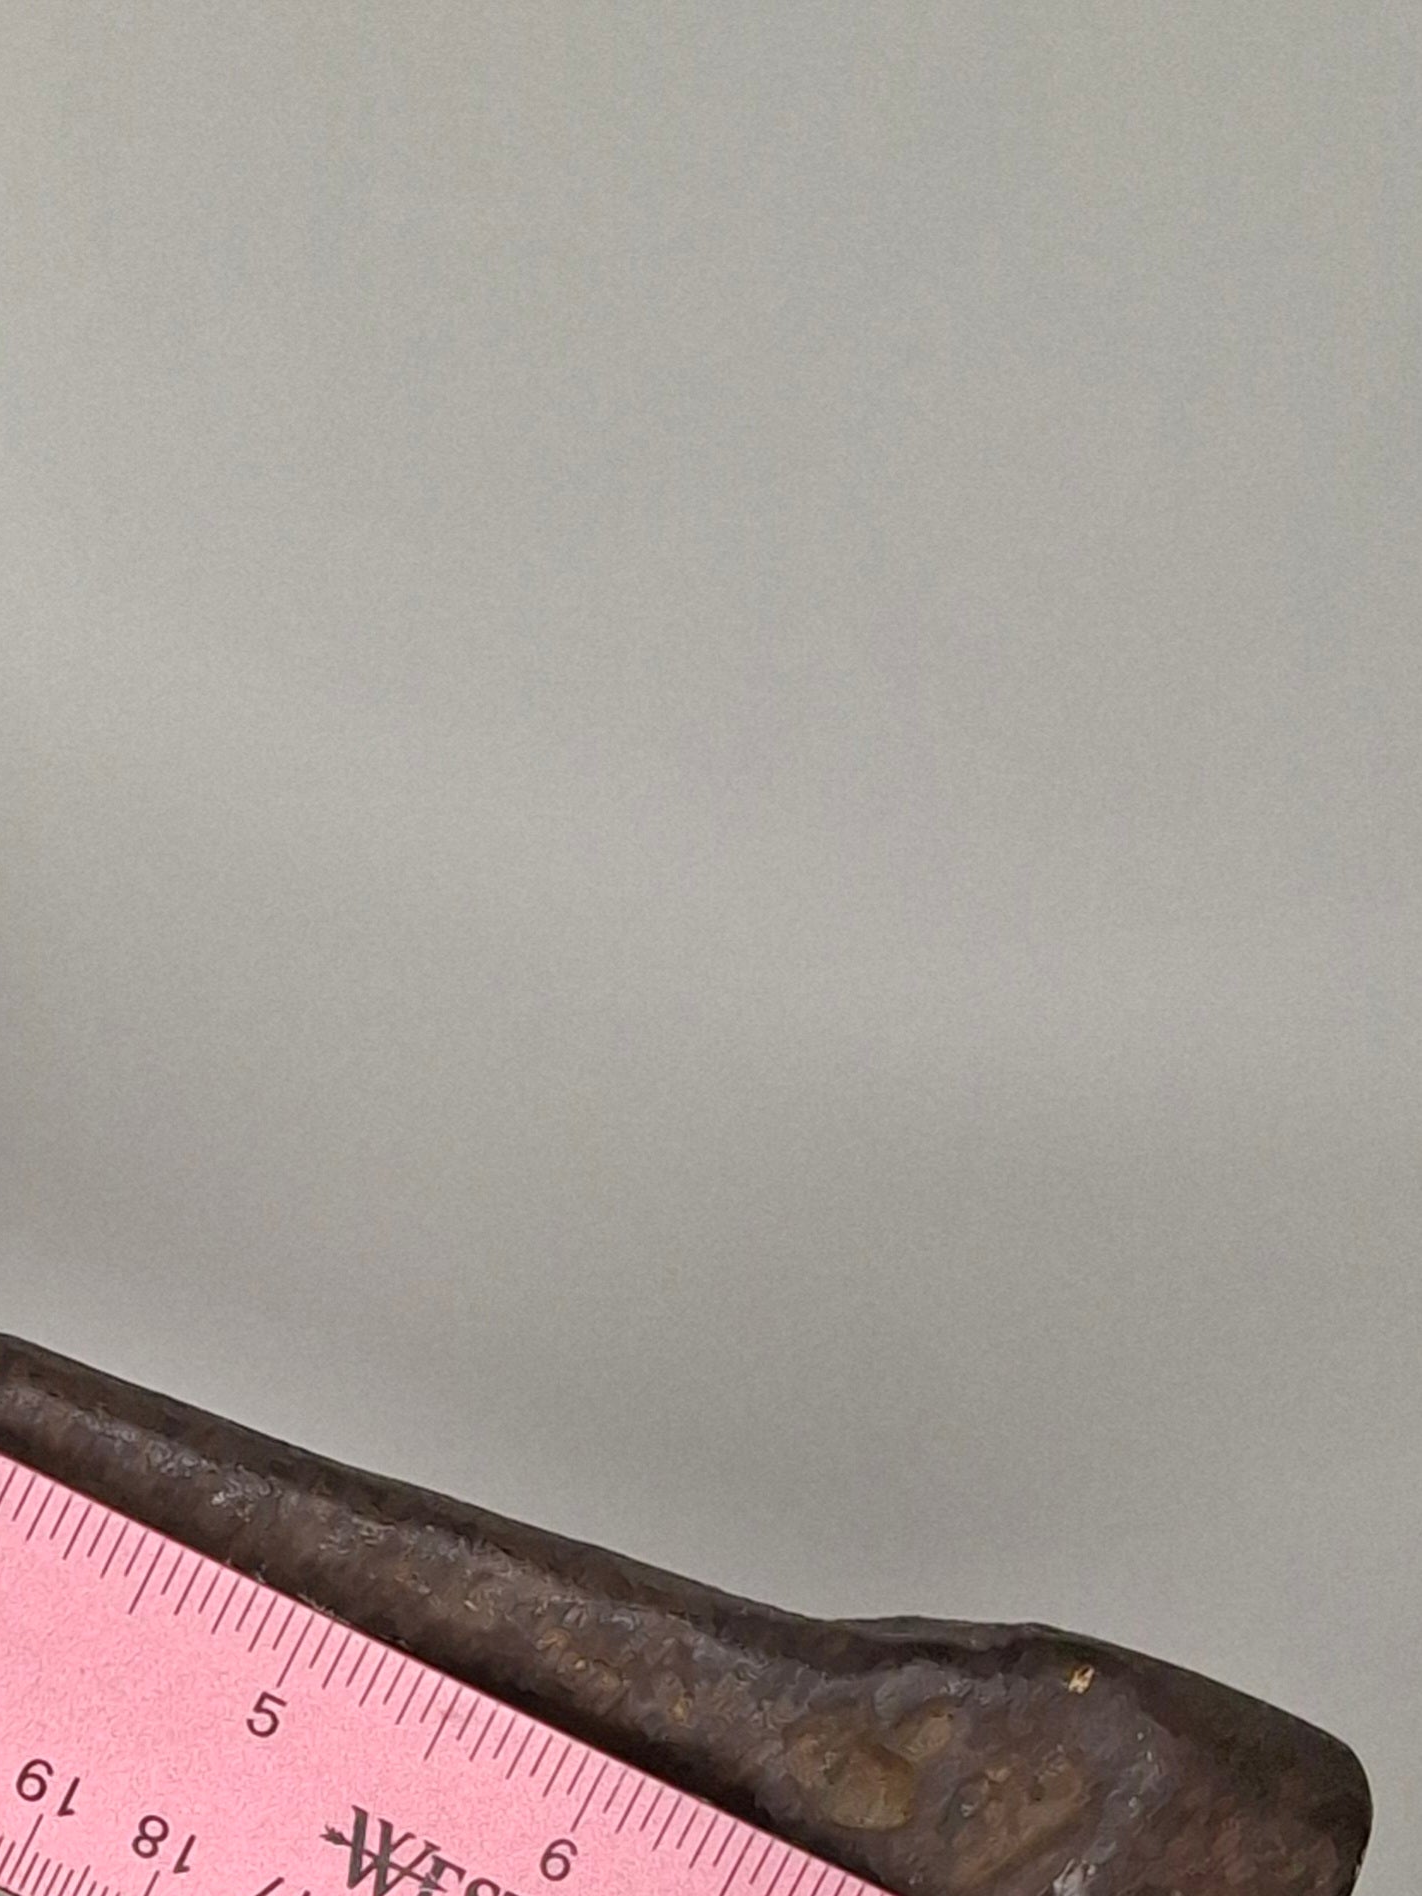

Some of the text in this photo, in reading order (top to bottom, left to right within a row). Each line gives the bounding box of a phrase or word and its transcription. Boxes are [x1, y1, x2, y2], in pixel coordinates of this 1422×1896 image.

[15, 1758, 81, 1818] 19
[246, 1690, 288, 1739] 5
[539, 1838, 579, 1882] 6
[131, 1814, 197, 1875] 18
